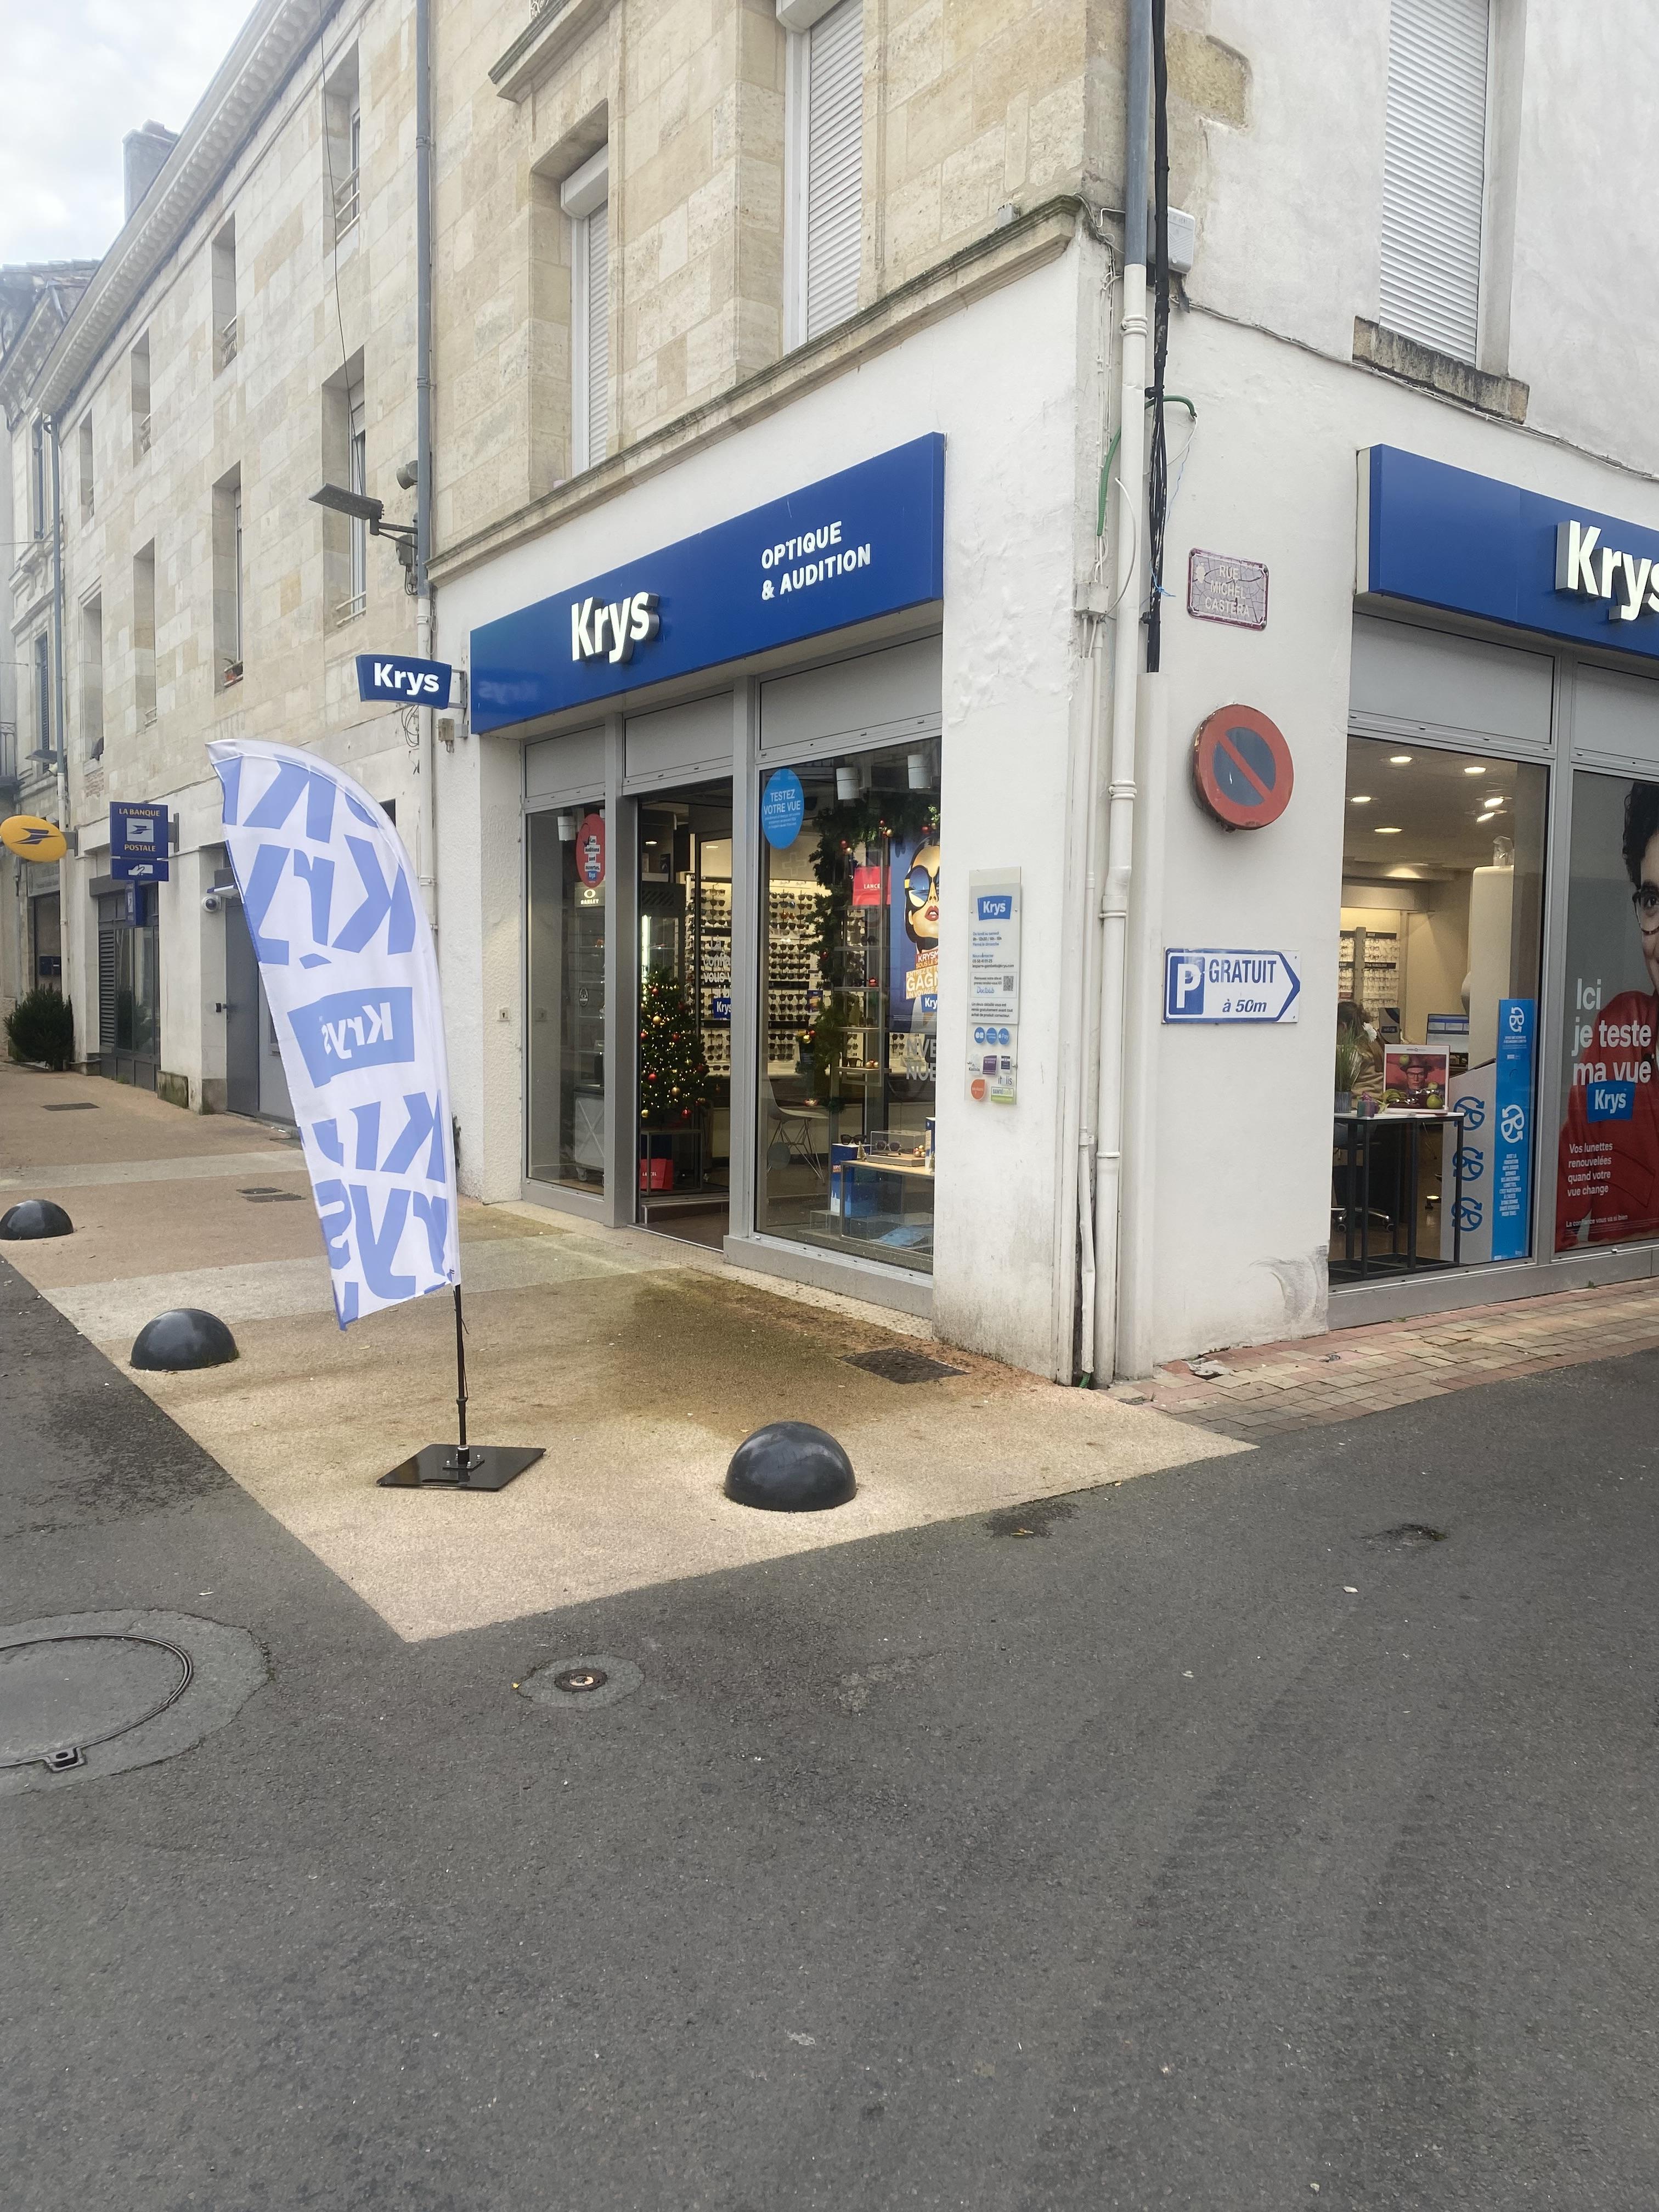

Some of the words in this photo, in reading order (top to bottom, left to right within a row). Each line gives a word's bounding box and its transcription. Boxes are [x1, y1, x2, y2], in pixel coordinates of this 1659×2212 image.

[761, 521, 842, 569] OPTIQUE
[761, 580, 775, 600] &
[780, 543, 871, 595] AUDITION
[1219, 565, 1239, 580] RUE
[1211, 580, 1246, 599] MICHEL
[571, 591, 653, 663] Krys
[374, 662, 439, 696] Krys
[770, 789, 795, 802] TESTEZ
[764, 803, 786, 815] VOTRE
[787, 800, 802, 811] VUE
[983, 901, 1006, 916] Krys
[703, 972, 725, 983] vous
[907, 969, 926, 978] ENTREZ
[1176, 963, 1201, 1008] P
[1209, 959, 1277, 983] GRATUIT
[913, 987, 934, 996] VOYAGE
[1576, 978, 1601, 1010] Ici
[1222, 998, 1231, 1012] à
[1235, 999, 1267, 1012] 50m
[1571, 1017, 1593, 1057] je
[1599, 1020, 1652, 1047] teste
[1573, 1062, 1607, 1086] ma
[1612, 1060, 1652, 1084] vue
[1594, 1089, 1627, 1114] Krys
[1569, 1143, 1583, 1154] Vos
[1584, 1142, 1613, 1153] lunettes
[1568, 1156, 1612, 1168] renouvelées
[1568, 1171, 1591, 1184] quand
[1593, 1171, 1611, 1180] votre
[1567, 1188, 1581, 1197] vue
[1582, 1185, 1609, 1196] change
